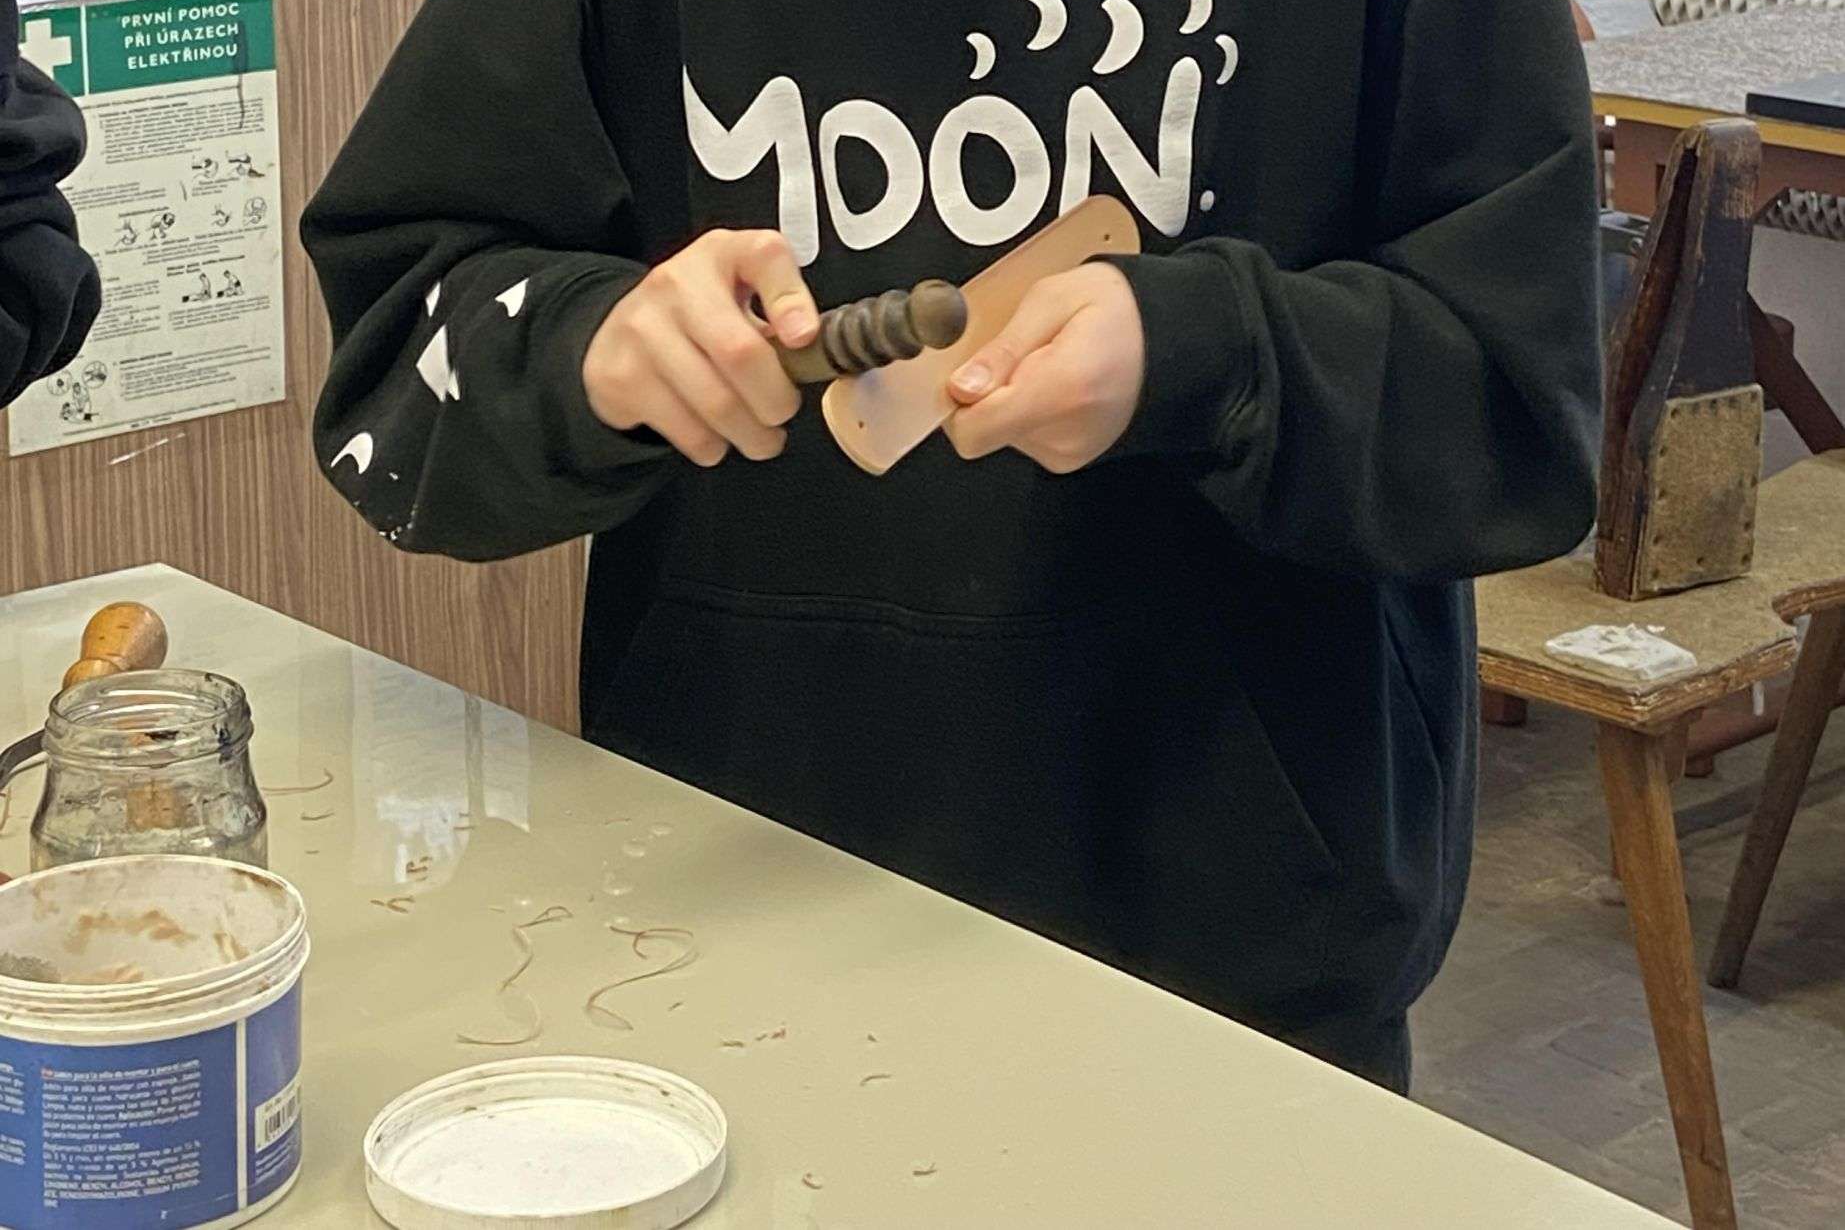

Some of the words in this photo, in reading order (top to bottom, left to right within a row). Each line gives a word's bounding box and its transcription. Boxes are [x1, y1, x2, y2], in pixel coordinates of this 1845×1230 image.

[121, 7, 172, 29] PRVNÍ
[178, 2, 240, 22] POMOC
[124, 31, 151, 49] PŘI
[156, 23, 239, 45] ÚRAZECH
[127, 43, 238, 70] ELEKTŘINOU
